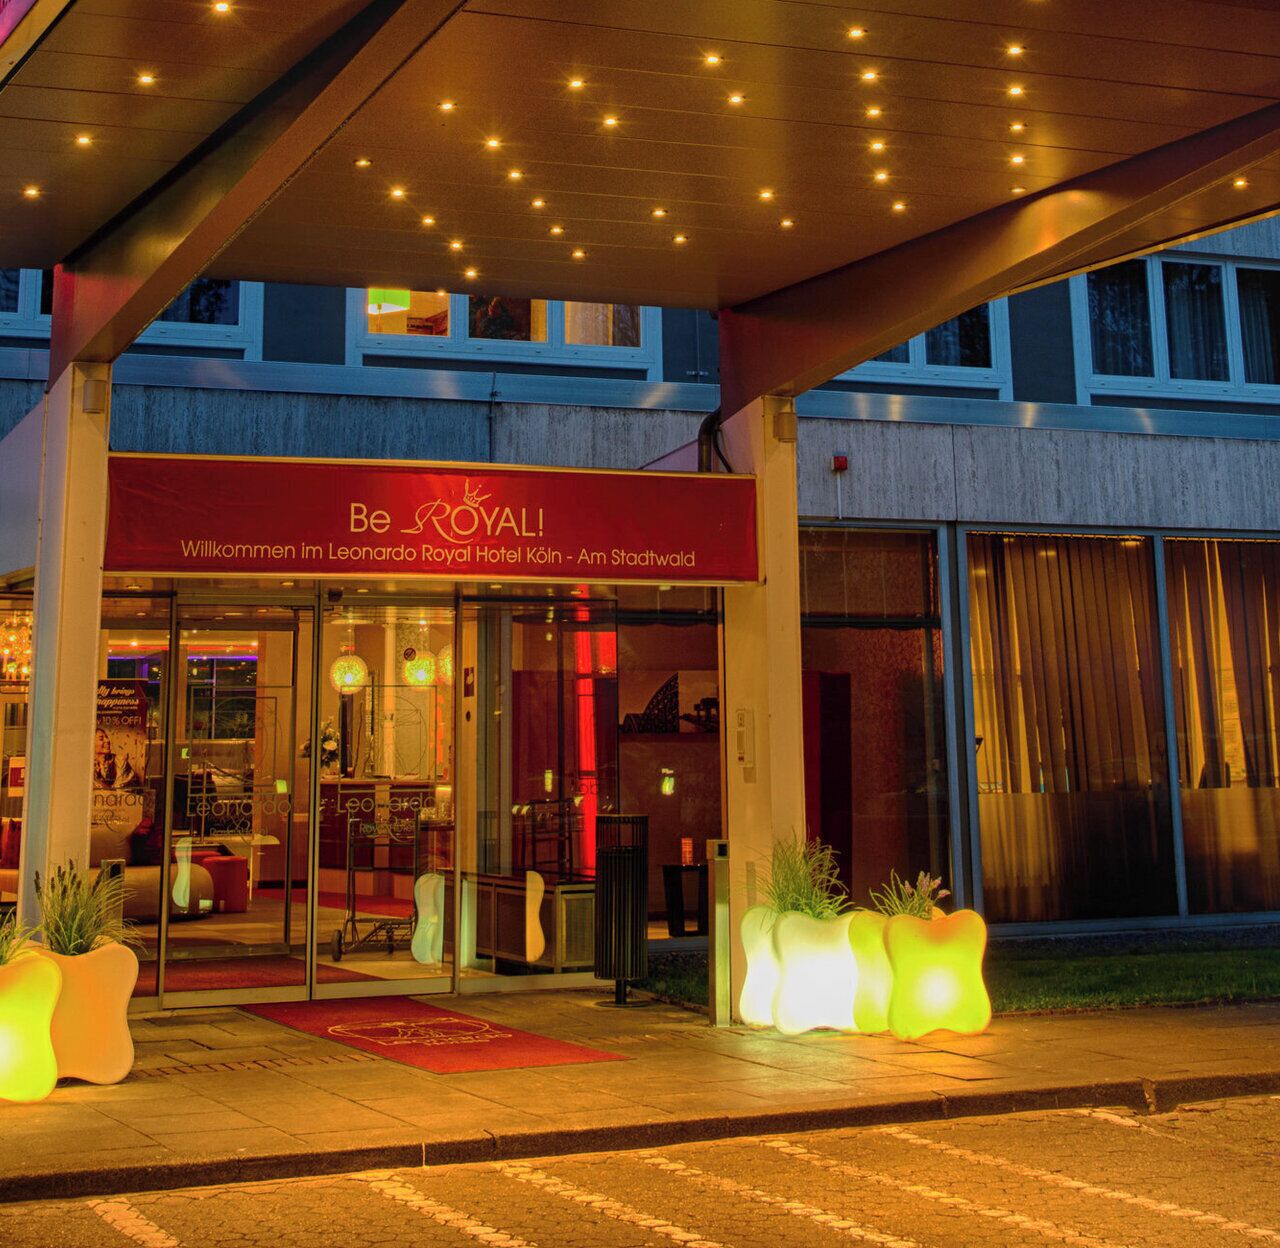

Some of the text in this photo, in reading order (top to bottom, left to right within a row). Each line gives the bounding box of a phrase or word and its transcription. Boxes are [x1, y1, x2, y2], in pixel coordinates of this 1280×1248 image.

[349, 498, 544, 544] Be ROYAL!
[181, 539, 296, 559] Willkommen
[301, 542, 323, 559] im
[328, 542, 417, 562] Leonardo
[422, 544, 471, 566] Royal
[476, 546, 521, 563] Hotel
[527, 546, 562, 564] Köln
[577, 548, 607, 565] Am
[612, 548, 696, 568] Stadtwald
[186, 794, 291, 817] Leonado
[337, 793, 437, 813] Leoardo
